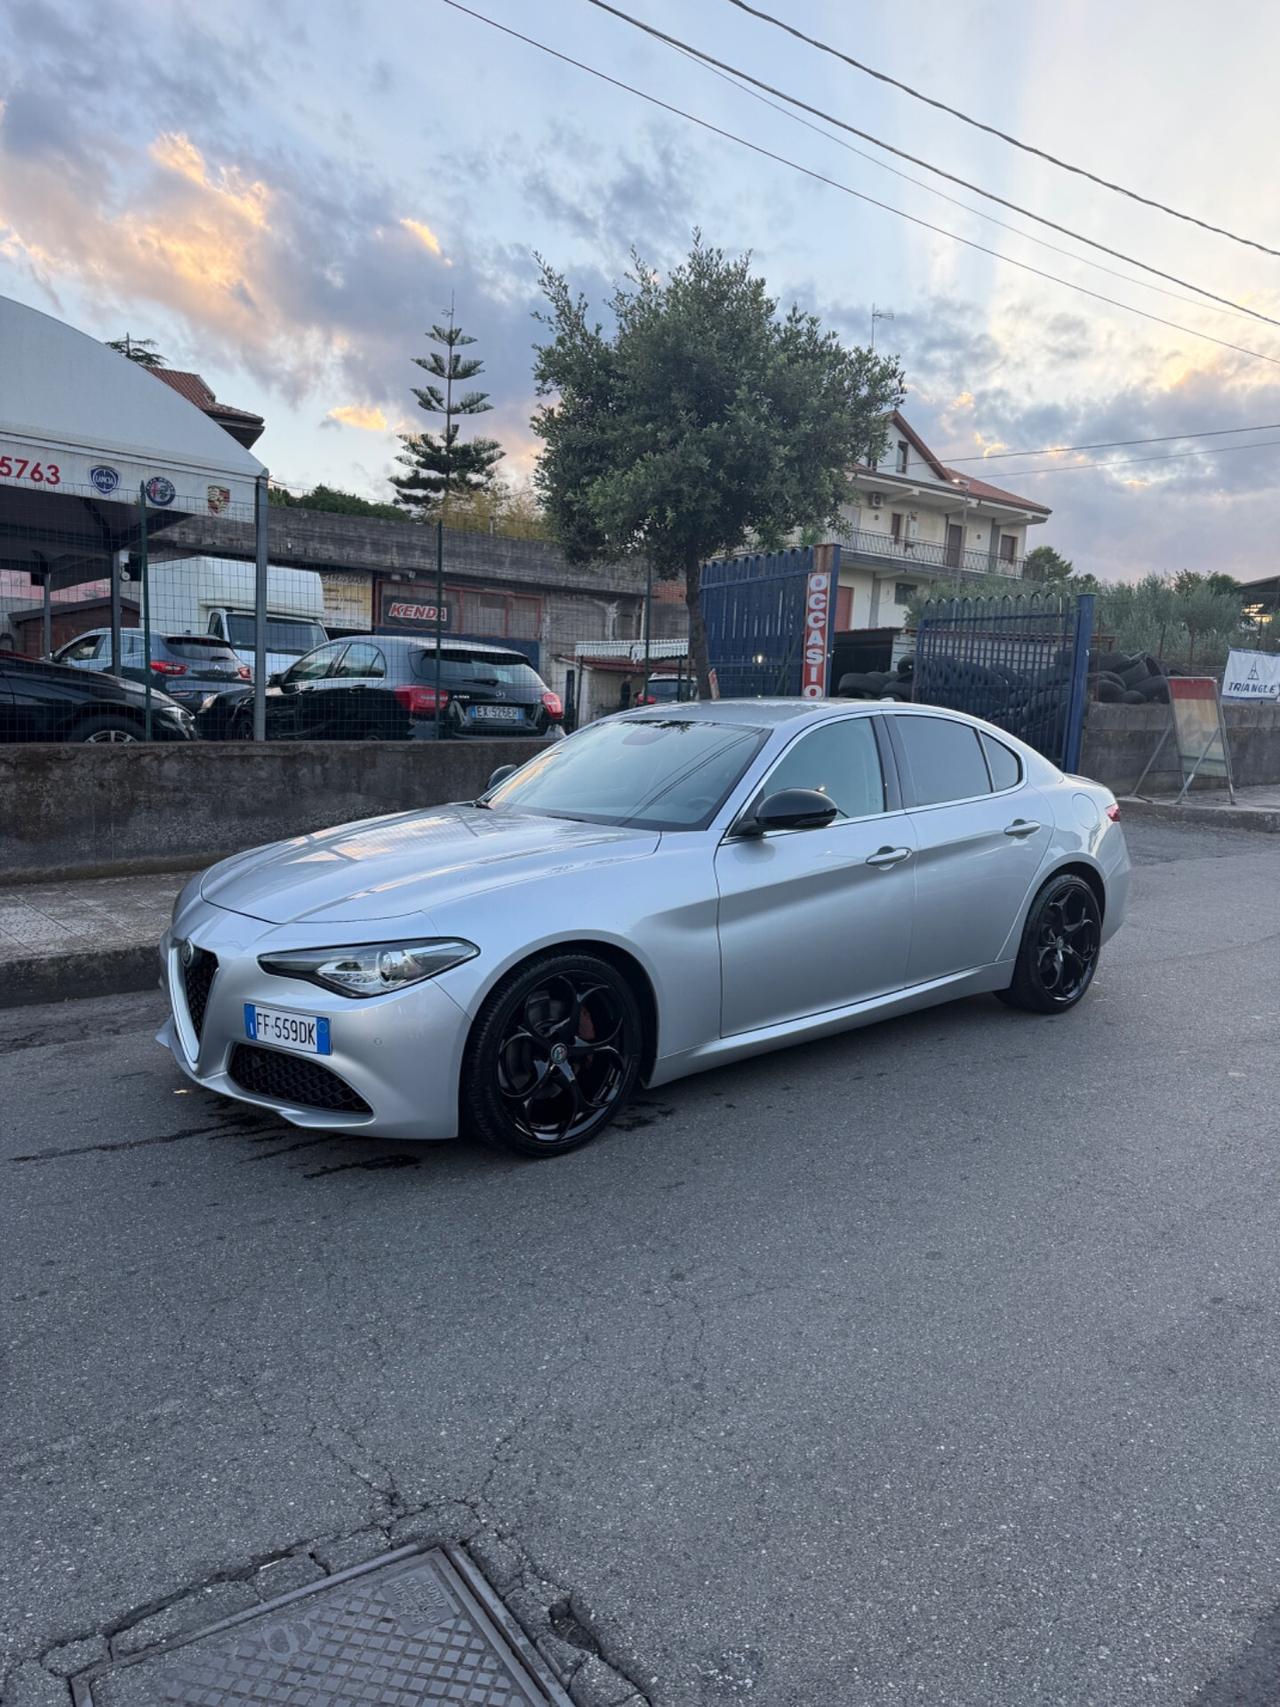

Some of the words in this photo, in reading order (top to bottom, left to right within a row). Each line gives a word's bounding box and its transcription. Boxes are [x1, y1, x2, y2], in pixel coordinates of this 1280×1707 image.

[0, 456, 61, 485] 5763
[803, 574, 828, 698] OCCASIO
[1229, 682, 1276, 694] TRIANGLE
